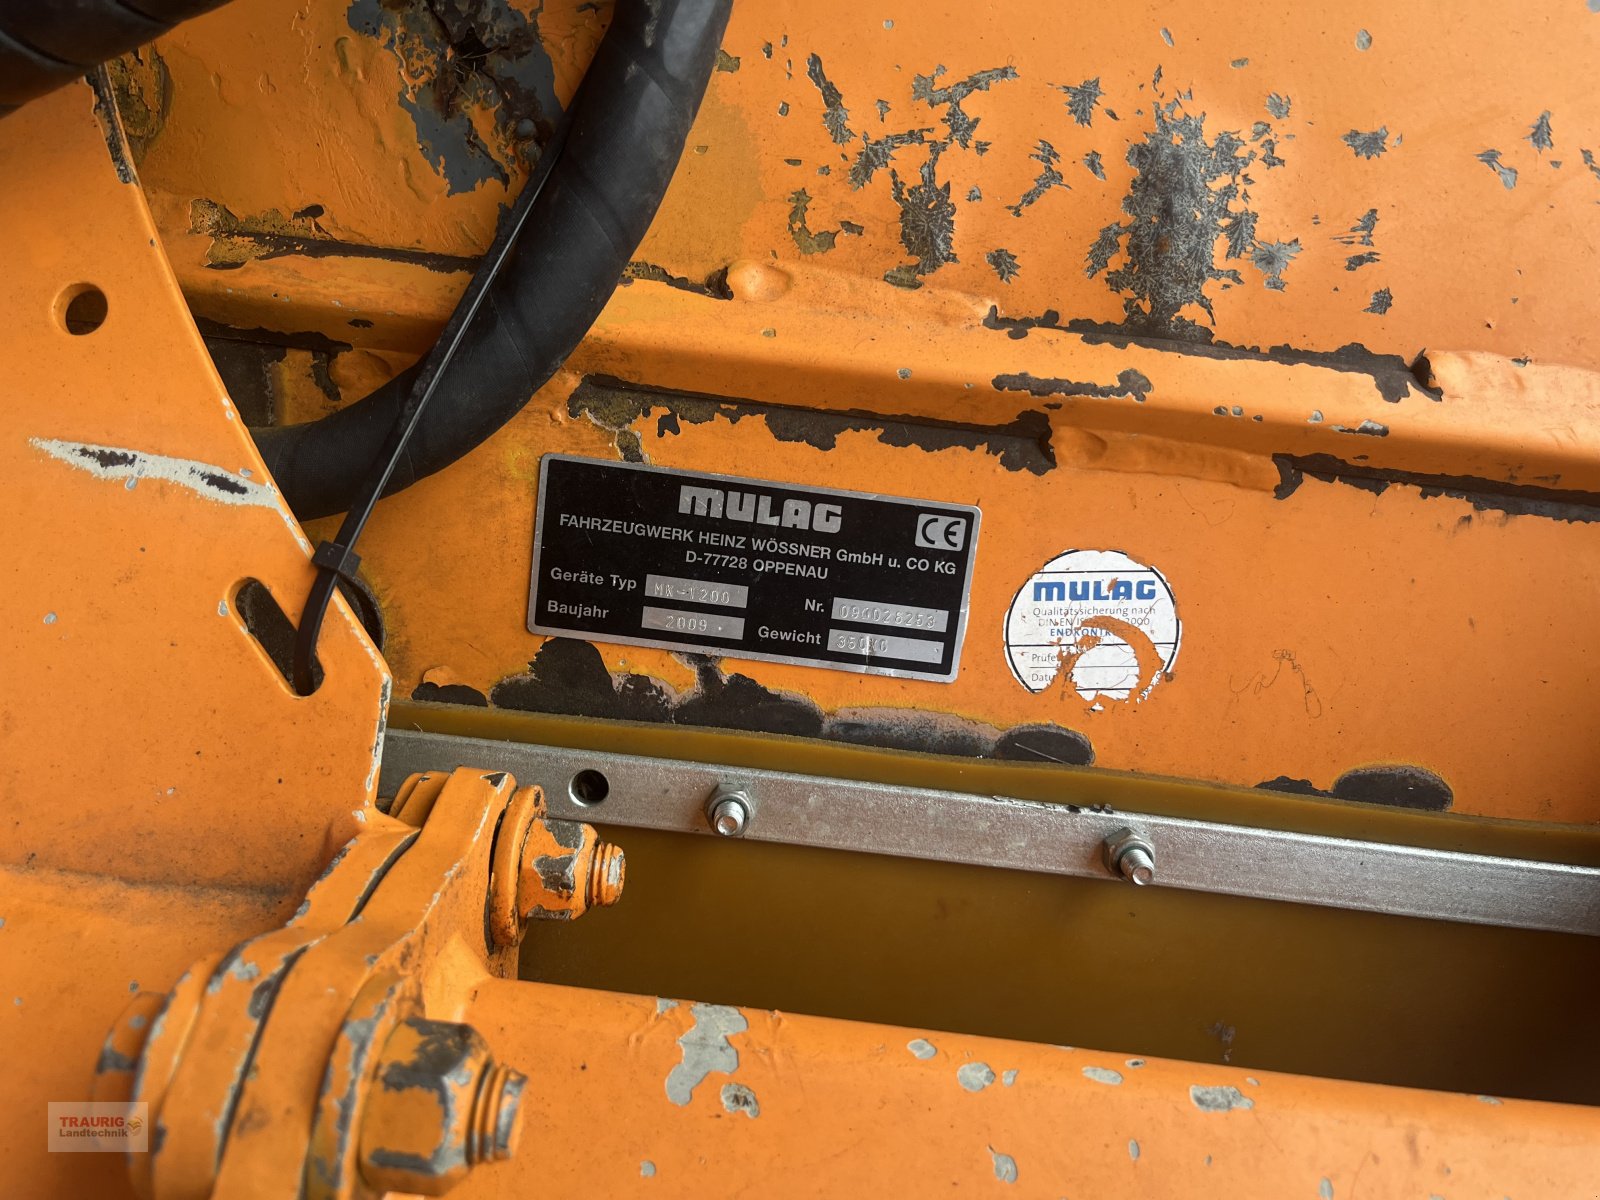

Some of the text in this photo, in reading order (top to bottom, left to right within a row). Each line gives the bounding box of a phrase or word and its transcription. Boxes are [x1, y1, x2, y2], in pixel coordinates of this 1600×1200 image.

[678, 484, 842, 533] MULAG
[559, 513, 957, 575] FAHRZEUGWERK HEINZ WÖSSNER GmbH u. CO KG
[686, 550, 829, 580] D-77728 OPPENAU
[550, 567, 604, 586] Geräte
[610, 574, 637, 592] Typ
[1033, 580, 1156, 602] MULAG
[547, 600, 609, 619] Baujahr
[804, 599, 825, 612] Nr.
[1131, 606, 1156, 615] nach
[757, 625, 822, 645] Gewicht
